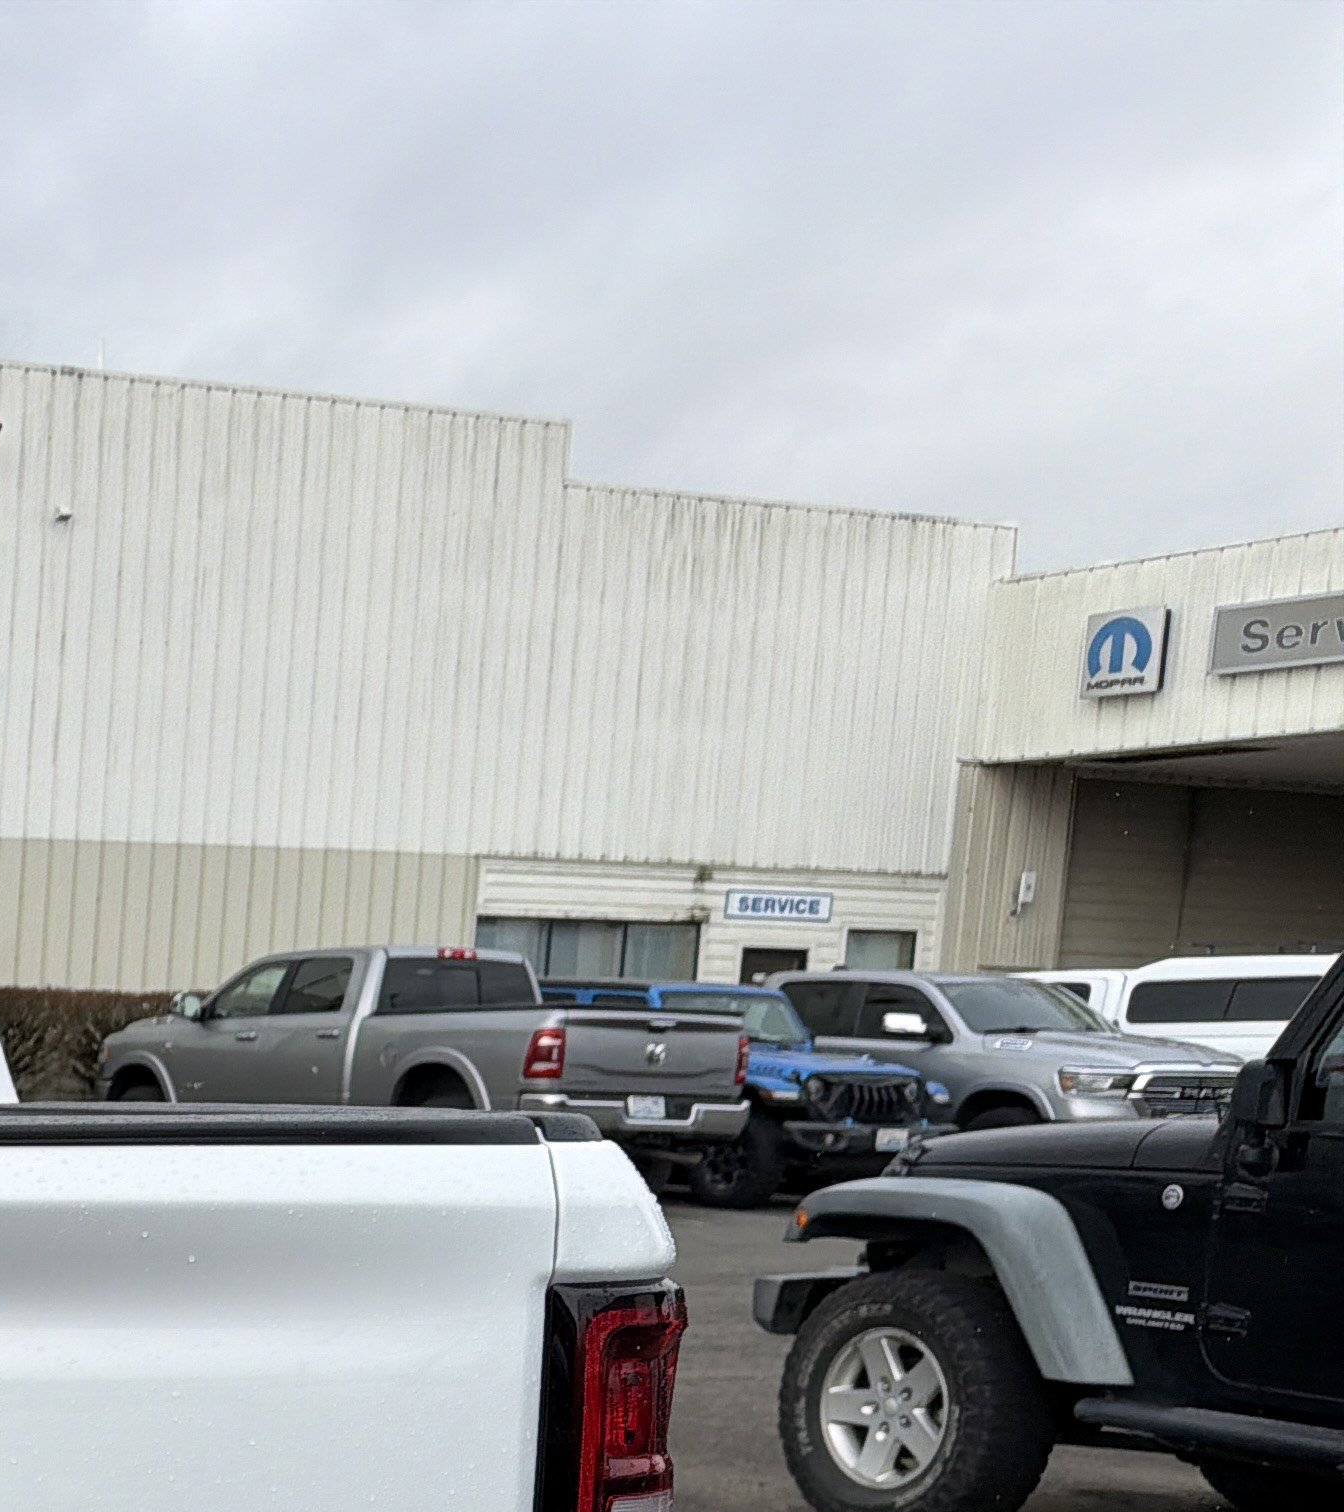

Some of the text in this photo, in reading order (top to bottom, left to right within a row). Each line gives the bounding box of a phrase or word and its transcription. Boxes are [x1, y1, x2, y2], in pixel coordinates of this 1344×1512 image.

[1086, 675, 1145, 690] MOPAR
[738, 896, 821, 915] SERVICE
[1115, 1304, 1195, 1325] WRANGLER
